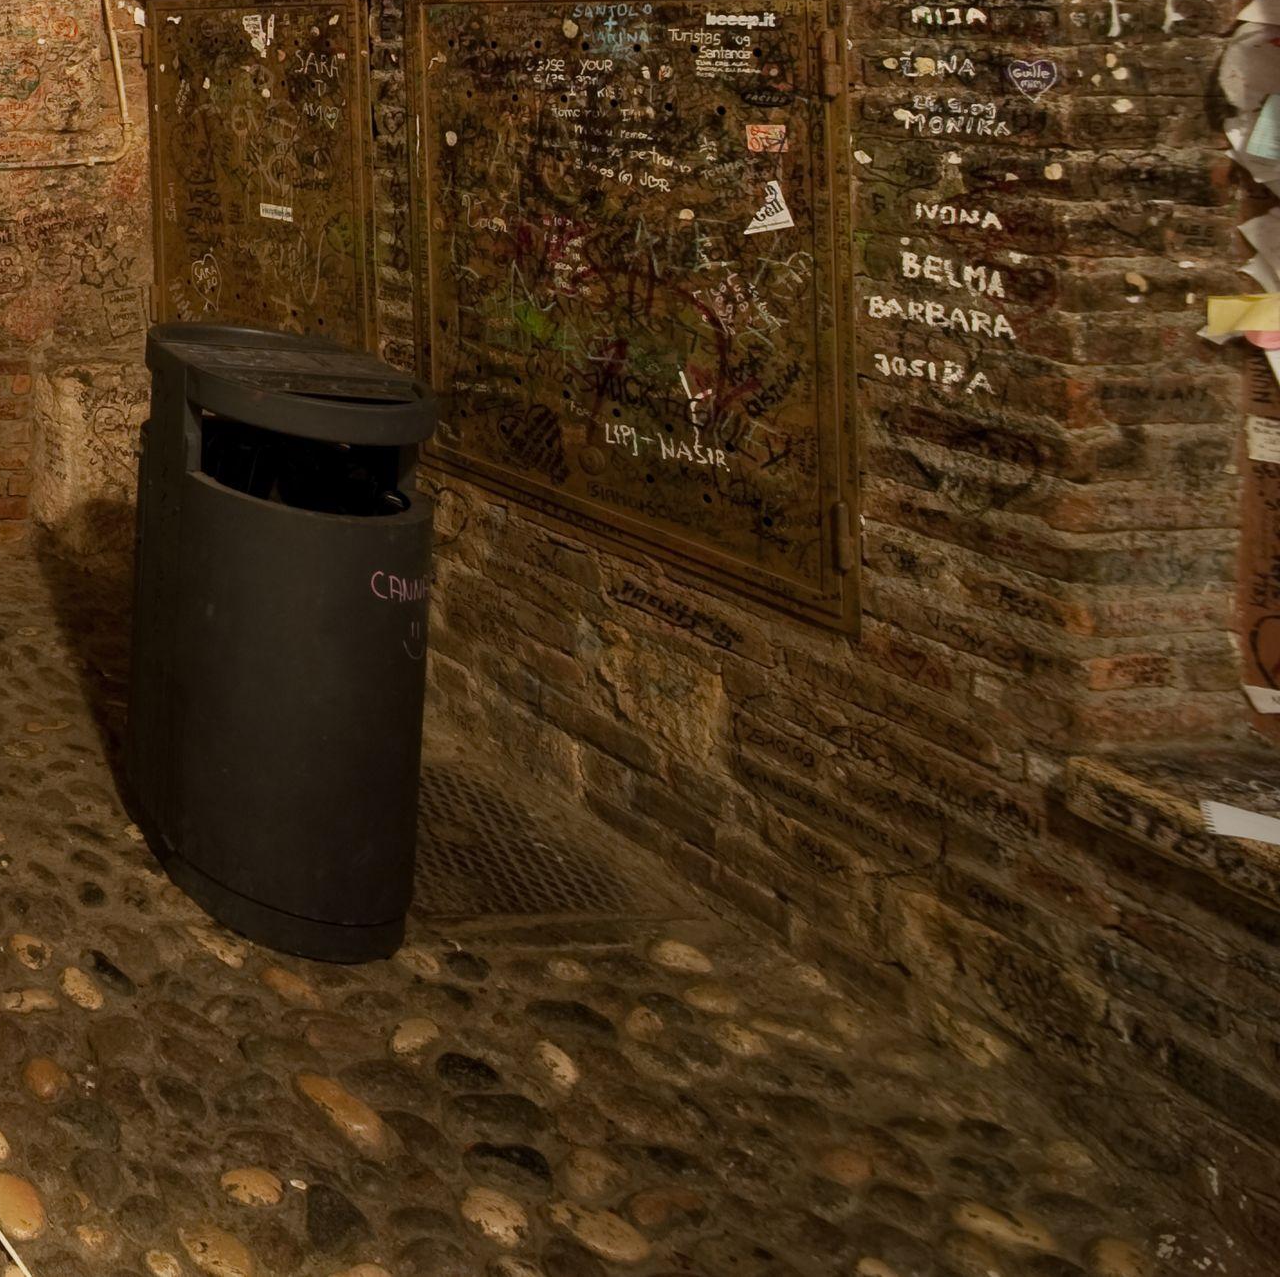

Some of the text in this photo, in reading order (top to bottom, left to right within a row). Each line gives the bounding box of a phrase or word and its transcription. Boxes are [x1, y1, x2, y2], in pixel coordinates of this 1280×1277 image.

[668, 27, 722, 46] Turistas
[904, 112, 1012, 137] MONIKA
[915, 201, 1003, 231] IVONA
[899, 251, 1006, 299] BELMA
[866, 294, 1017, 340] BARBARA
